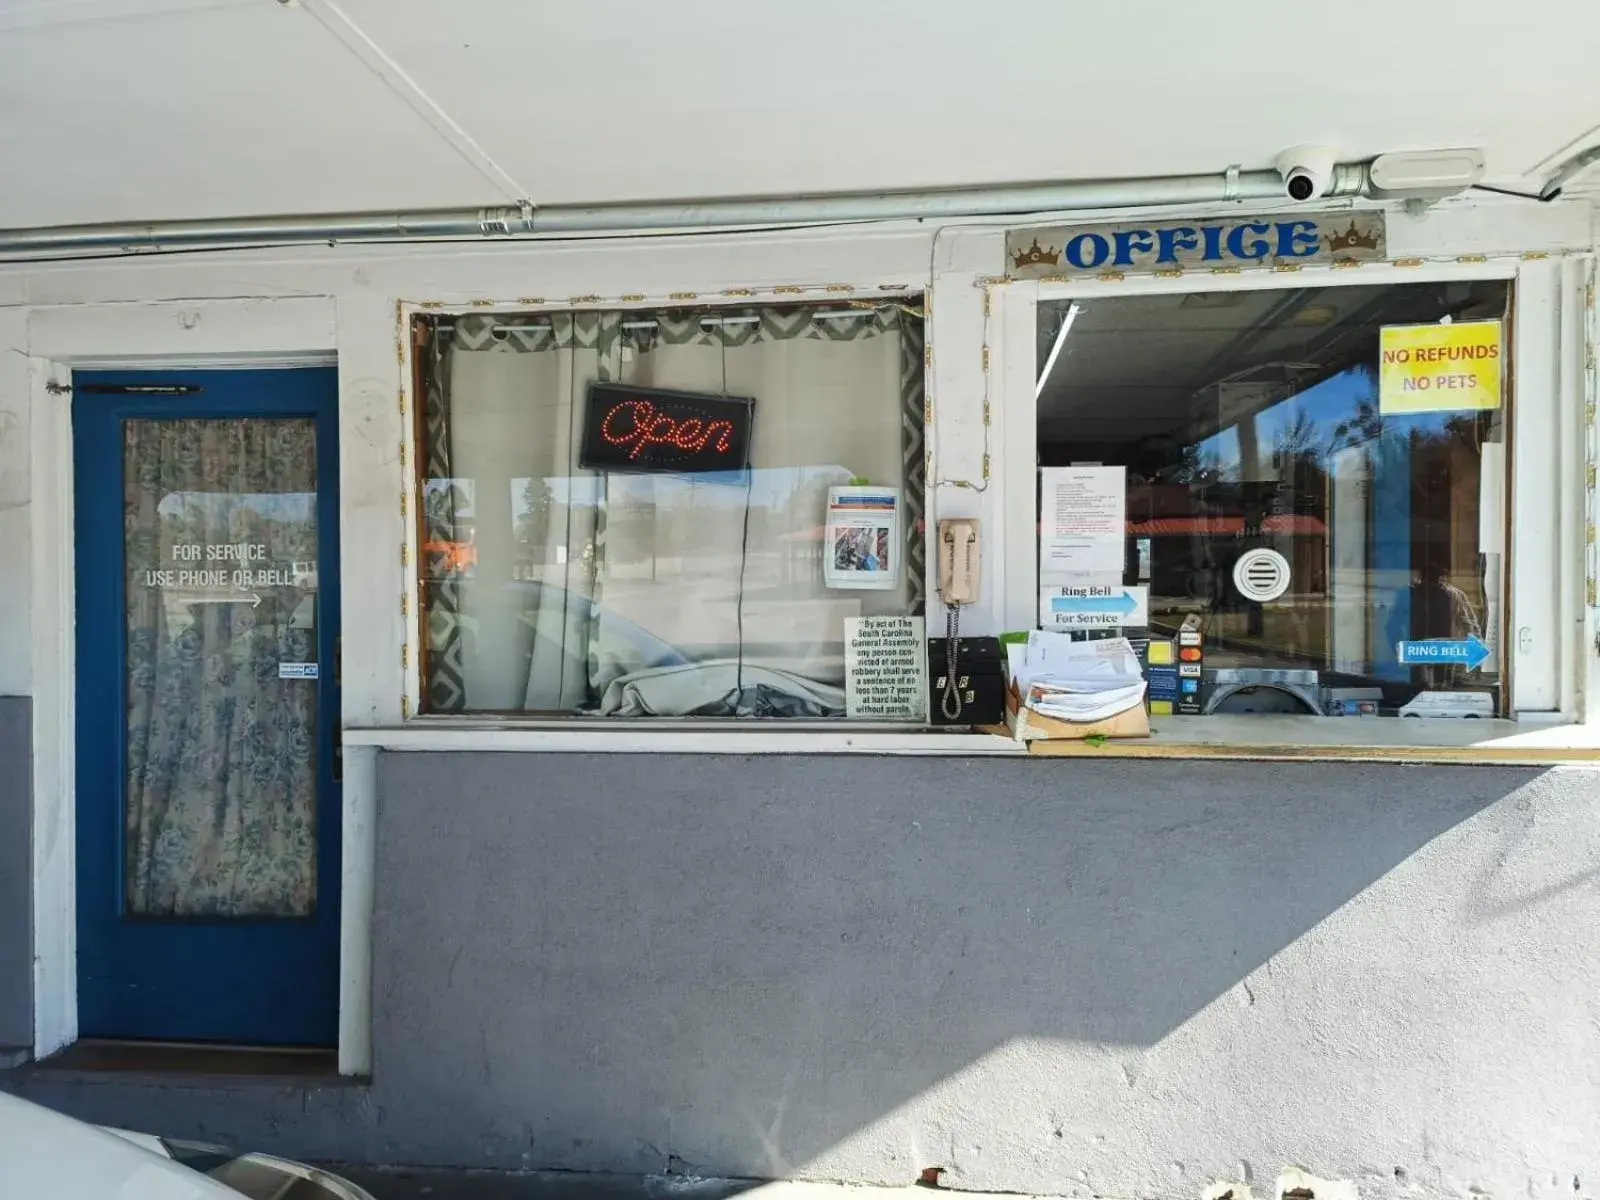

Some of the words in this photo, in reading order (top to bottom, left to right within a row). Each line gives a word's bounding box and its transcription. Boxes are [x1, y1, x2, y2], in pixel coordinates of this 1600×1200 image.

[1065, 221, 1320, 268] OFFICE
[1383, 349, 1410, 363] NO
[1415, 345, 1499, 362] REFUNDS
[1403, 376, 1431, 391] NO
[1436, 374, 1477, 389] PETS
[603, 400, 733, 460] Open
[172, 544, 201, 560] FOR
[206, 543, 266, 560] SERVICE
[146, 570, 174, 587] USE
[179, 570, 228, 586] PHONE
[232, 570, 253, 586] OR
[258, 570, 293, 585] BELL
[1061, 586, 1087, 598] Ring
[1089, 585, 1112, 596] Bell
[1056, 614, 1075, 623] For
[1076, 613, 1119, 623] Service
[888, 619, 896, 628] of
[898, 619, 913, 628] The
[881, 629, 913, 637] Carolina
[852, 639, 881, 647] General
[883, 638, 920, 648] Assembly
[857, 650, 870, 658] any
[872, 649, 897, 657] person
[1407, 646, 1438, 656] RING
[1441, 646, 1469, 656] BELL
[852, 667, 881, 676] robbery
[883, 667, 900, 675] shall
[901, 667, 920, 675] serve
[871, 686, 889, 694] than
[889, 686, 895, 694] 7
[896, 687, 917, 696] years
